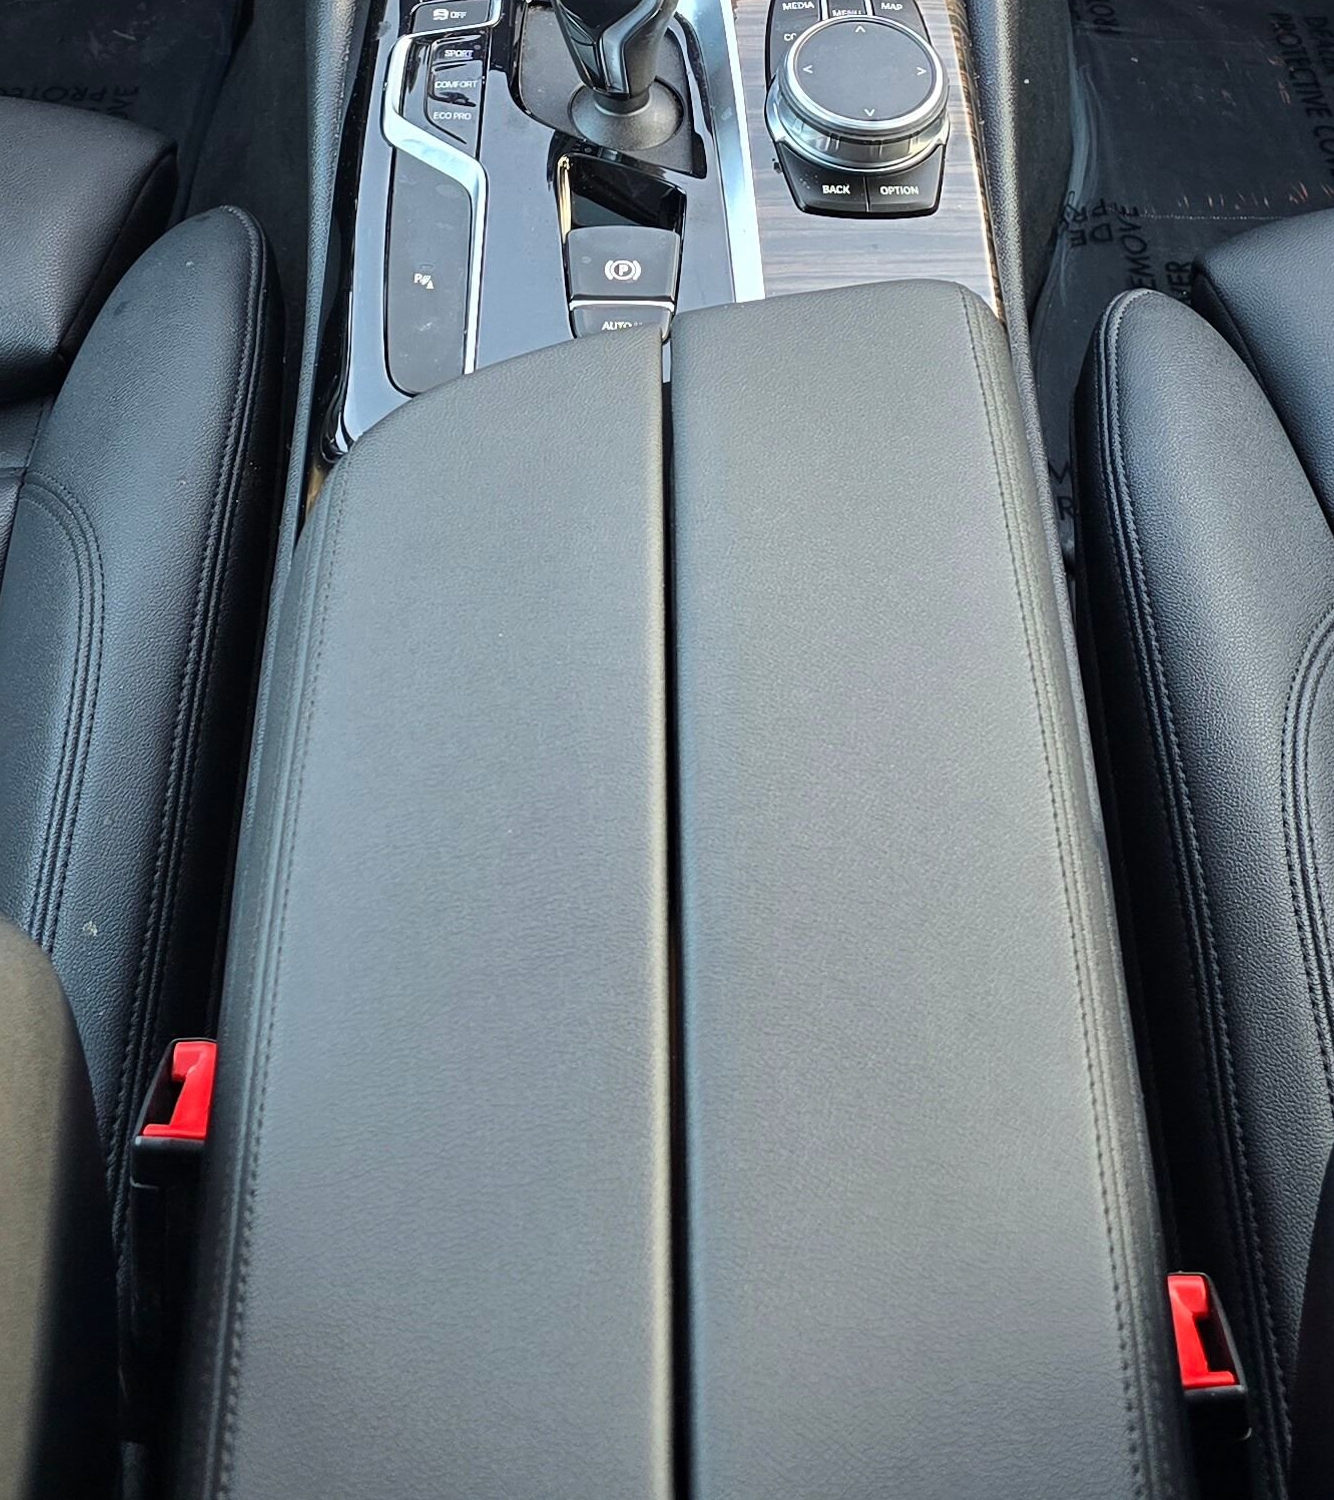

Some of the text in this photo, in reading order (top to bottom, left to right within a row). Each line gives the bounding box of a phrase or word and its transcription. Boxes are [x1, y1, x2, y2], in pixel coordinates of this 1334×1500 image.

[781, 0, 815, 11] MEDIA
[880, 1, 903, 11] MAP
[449, 11, 468, 19] OFF
[444, 49, 475, 59] SPORT
[434, 79, 478, 90] COMFORT
[433, 111, 472, 121] ECO PRO
[821, 184, 851, 195] BACK
[879, 185, 920, 196] OPTION
[1113, 202, 1157, 290] EMOVE
